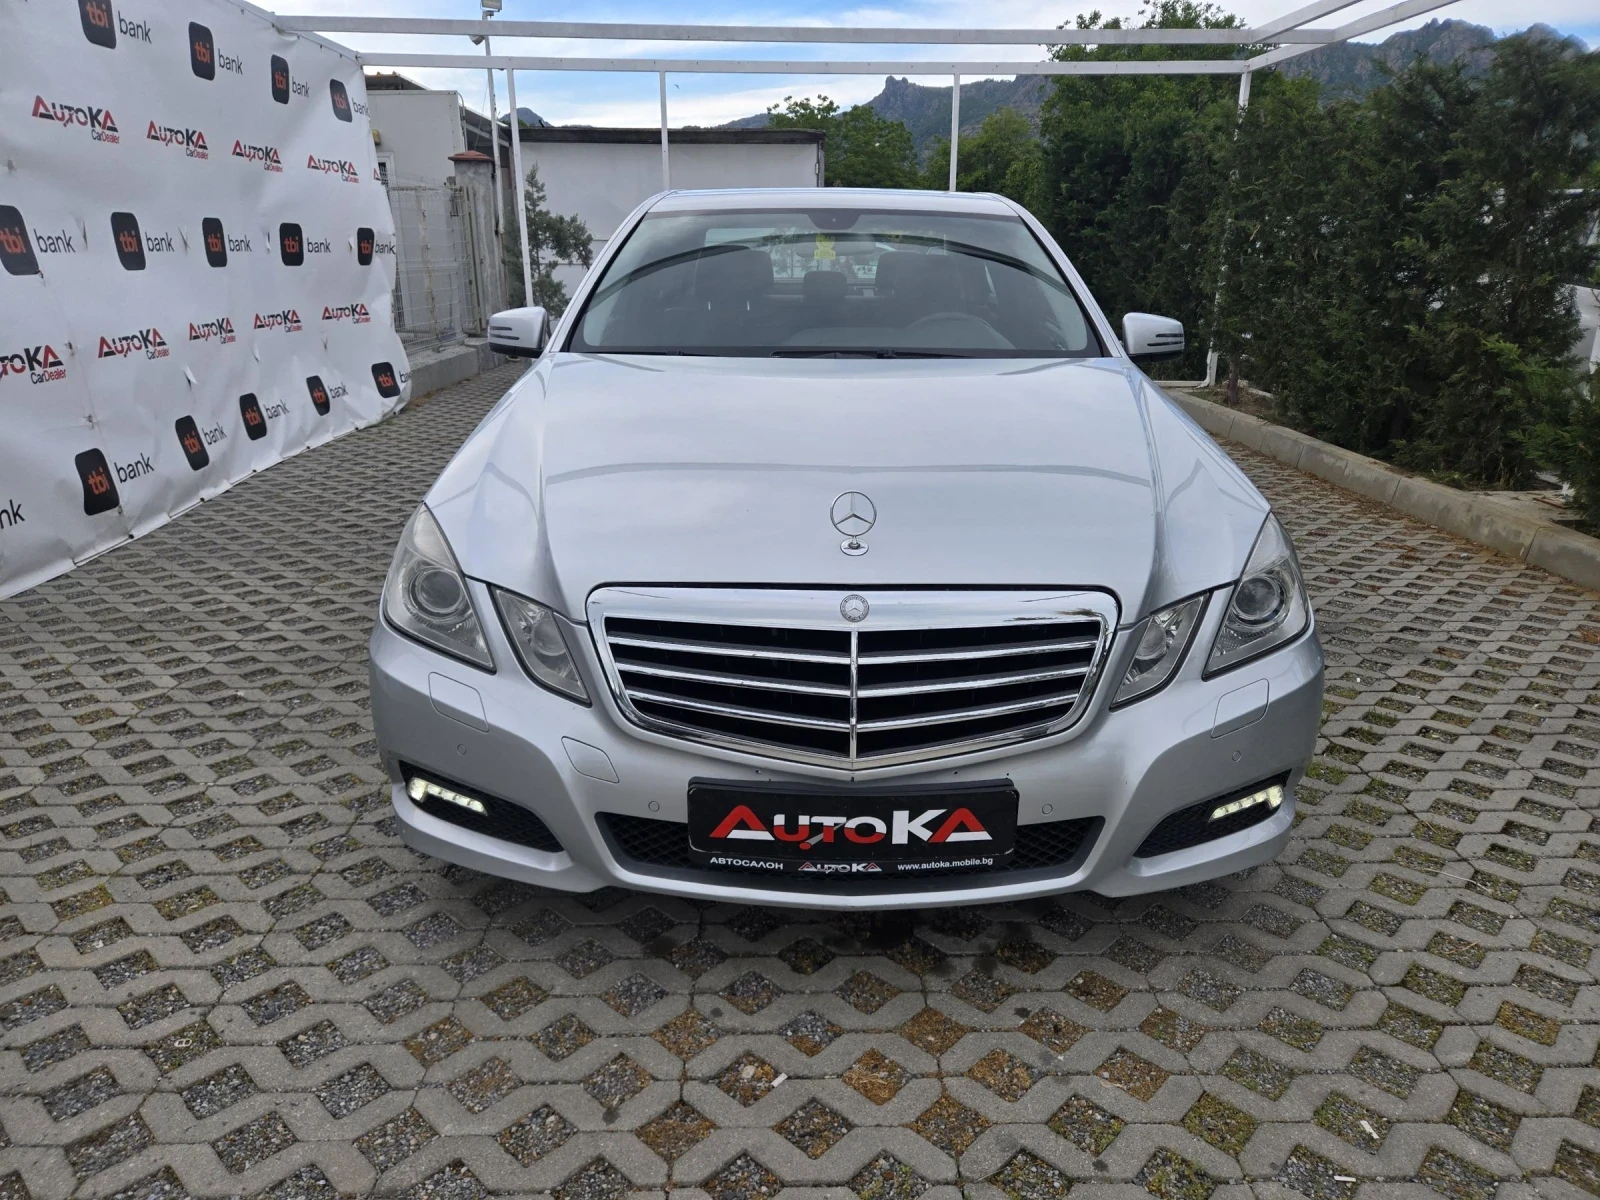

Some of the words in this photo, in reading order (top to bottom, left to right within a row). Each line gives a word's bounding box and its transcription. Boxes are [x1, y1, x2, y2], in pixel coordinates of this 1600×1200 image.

[87, 1, 109, 29] tbi
[118, 11, 151, 44] bank
[195, 42, 210, 64] tbi
[218, 49, 242, 75] bank
[275, 71, 286, 90] tbi
[292, 77, 309, 98] bank
[334, 92, 347, 110] tbi
[92, 130, 119, 145] CarDealer
[34, 229, 75, 254] bank
[120, 231, 137, 253] tbi
[146, 232, 174, 252] bank
[209, 234, 221, 253] tbi
[228, 235, 251, 253] bank
[284, 237, 298, 253] tbi
[307, 238, 331, 254] bank
[376, 242, 395, 255] bank
[31, 369, 66, 385] CarDealer
[379, 373, 393, 388] tbi
[313, 387, 326, 404] tbi
[328, 381, 348, 400] bank
[245, 407, 260, 426] tbi
[264, 399, 289, 420] bank
[185, 431, 200, 454] tbi
[202, 422, 227, 446] bank
[89, 468, 109, 495] tbi
[115, 454, 154, 484] bank
[0, 500, 24, 530] nk
[709, 856, 784, 871] АВТОСАЛОН
[897, 856, 994, 872] www.autoka.mobile.bg
